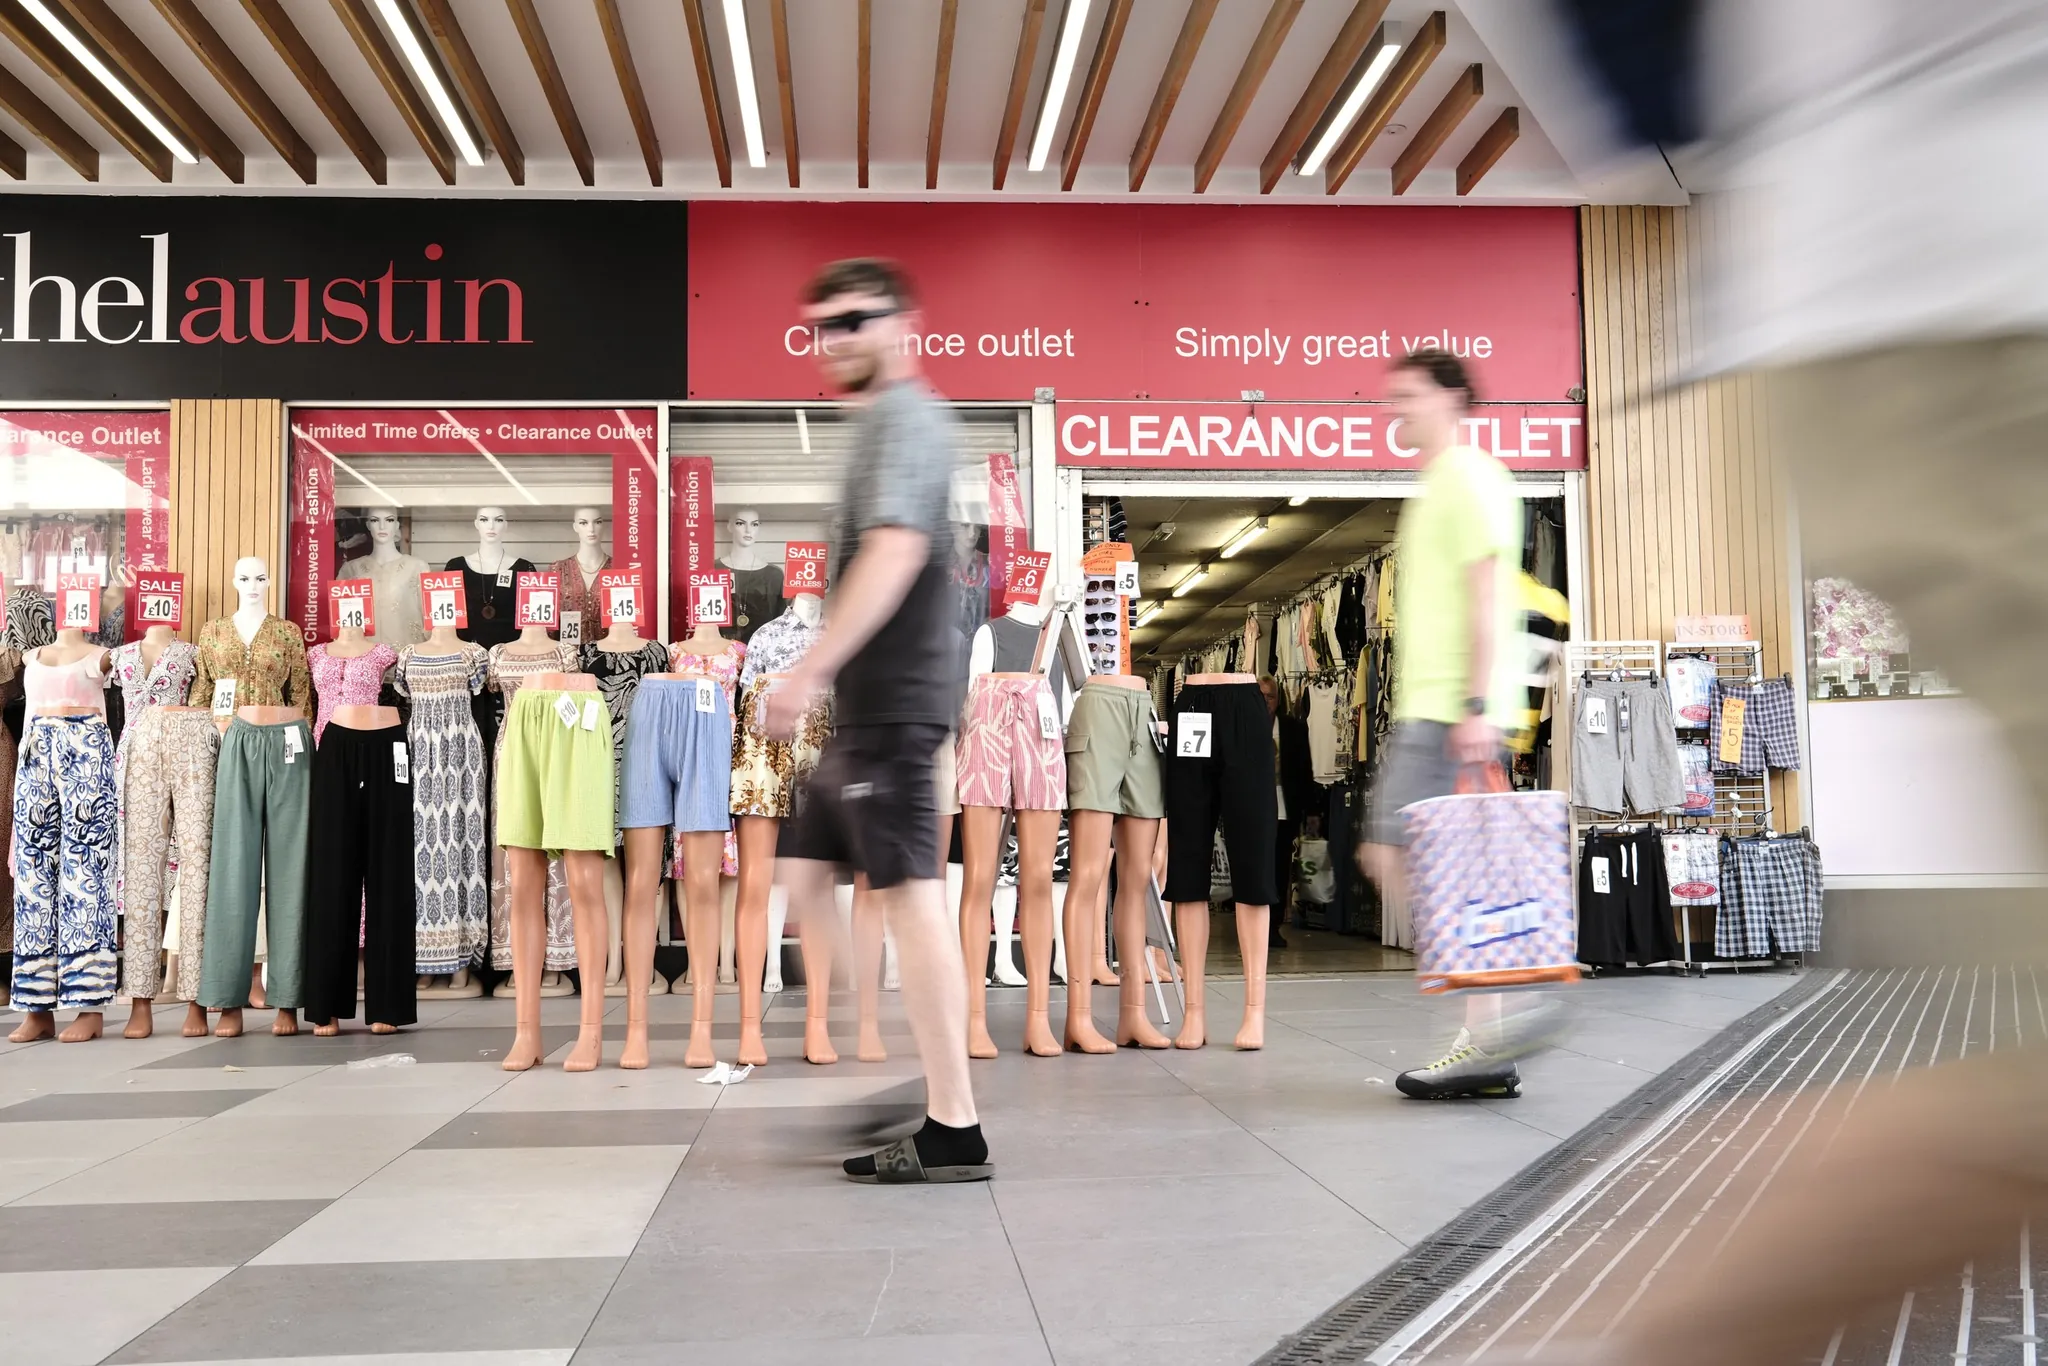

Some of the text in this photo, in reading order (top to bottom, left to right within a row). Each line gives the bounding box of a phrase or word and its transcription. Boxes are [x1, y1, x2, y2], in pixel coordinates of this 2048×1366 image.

[784, 325, 1075, 357] Clnce outlet
[1175, 326, 1493, 365] Simply great value
[92, 426, 161, 445] Outlet
[297, 423, 653, 439] Limited Time Offers Clearance Outlet
[1061, 414, 1581, 458] CLEARANCE OTLET
[686, 471, 699, 528] Fashion
[629, 467, 642, 550] Ladieswear
[1003, 469, 1017, 549] Ladieswear
[304, 467, 319, 643] Childrenswear Fashion
[788, 547, 826, 560] SALE
[1016, 555, 1049, 569] SALE
[689, 573, 729, 585] SALE
[796, 561, 816, 580] £8
[1017, 569, 1037, 587] £6
[60, 576, 96, 590] SALE
[139, 579, 182, 592] SALE
[423, 577, 463, 590] SALE
[519, 576, 558, 587] SALE
[602, 575, 641, 587] SALE
[789, 580, 801, 588] OR
[803, 580, 822, 588] LESS
[1119, 573, 1135, 590] £5
[331, 585, 371, 598] SALE
[1022, 587, 1039, 595] LESS
[68, 603, 88, 620] £15
[148, 599, 171, 616] £10
[433, 603, 454, 620] £15
[531, 604, 551, 621] £15
[613, 599, 634, 616] £15
[702, 599, 722, 617] £15
[341, 610, 363, 627] £18
[561, 622, 579, 639] £25
[1677, 624, 1749, 637] IN-STORE
[215, 691, 233, 709] £25
[700, 688, 711, 706] £8
[560, 700, 576, 722] £10
[1589, 710, 1606, 728] £10
[1183, 730, 1207, 753] £7
[396, 762, 407, 778] £10
[1597, 870, 1607, 886] £5
